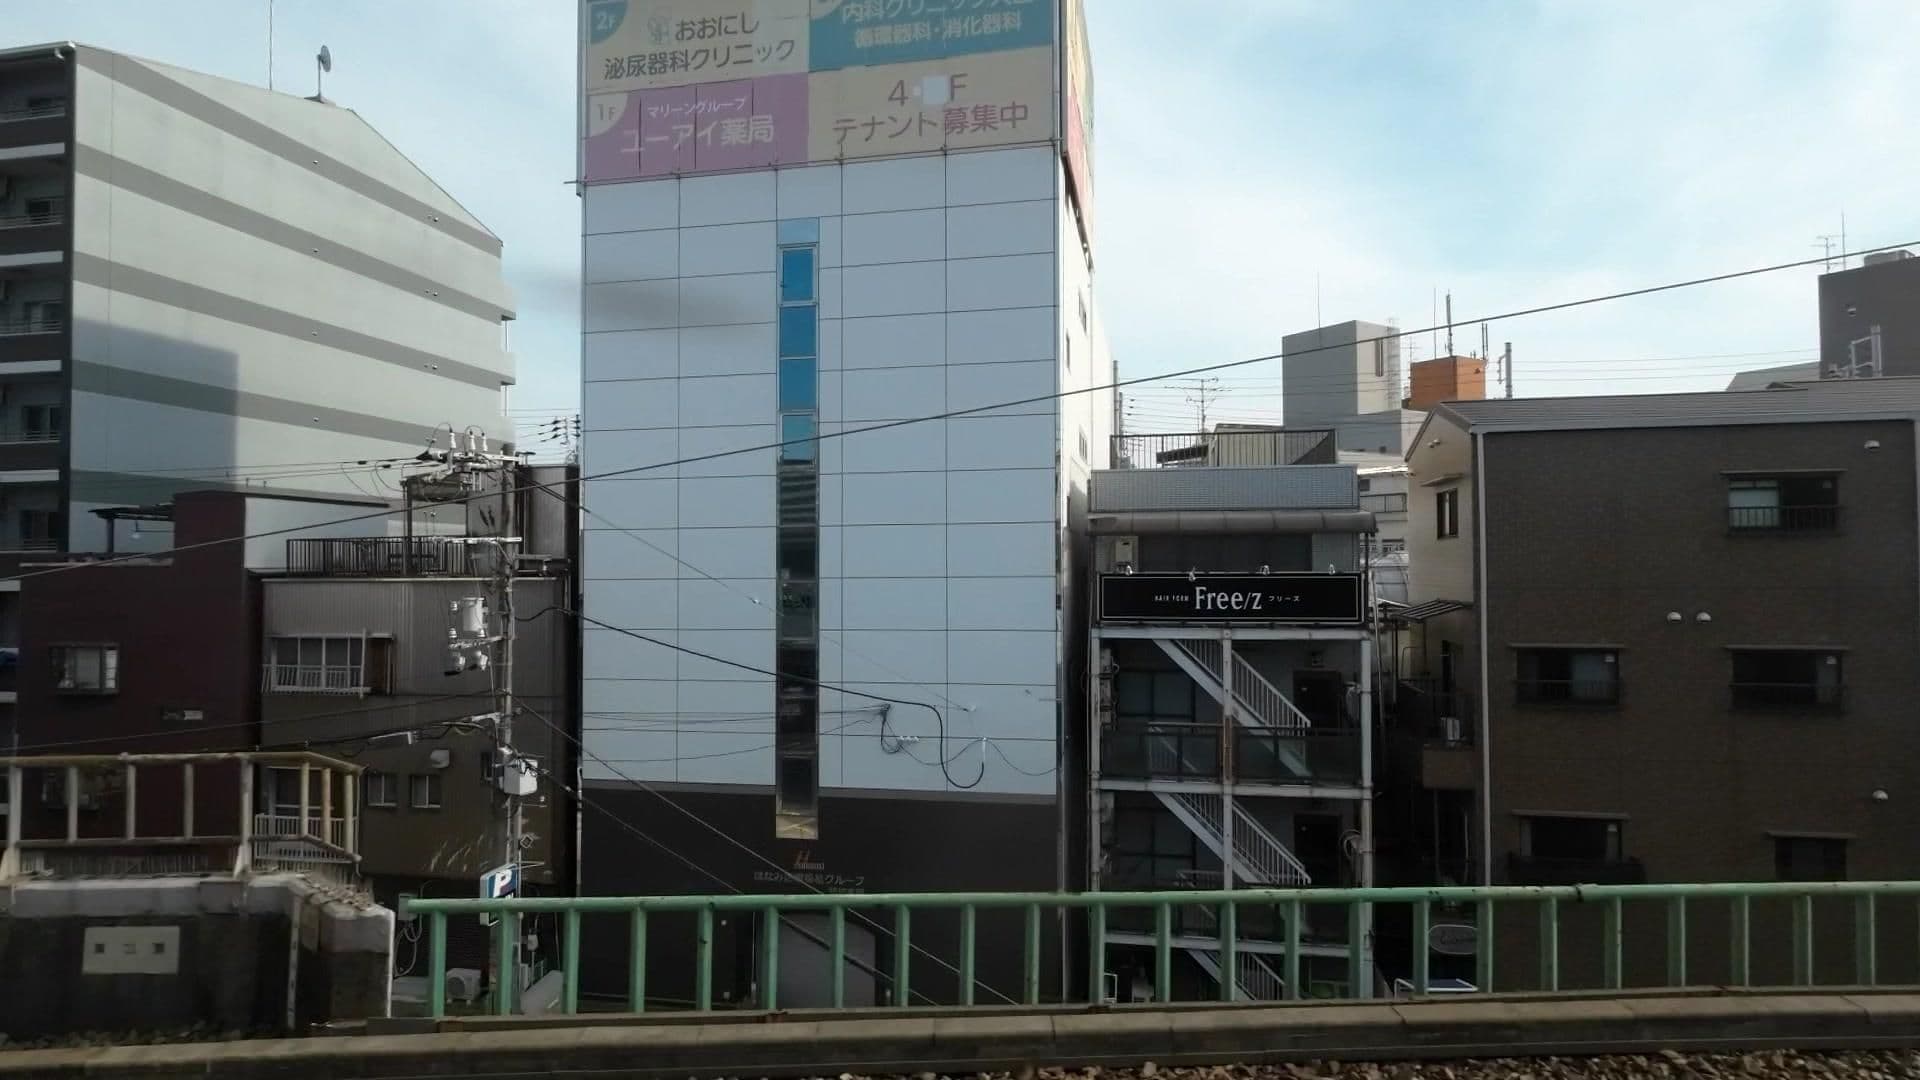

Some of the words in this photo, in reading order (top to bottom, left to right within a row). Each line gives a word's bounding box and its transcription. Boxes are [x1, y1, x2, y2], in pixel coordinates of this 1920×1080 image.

[596, 12, 616, 30] 2F
[675, 12, 759, 40] おおにし
[604, 40, 795, 79] 泌尿器科クリニック
[598, 104, 616, 120] 1F
[648, 98, 746, 118] マリーングループ
[621, 115, 774, 152] ユーアイ薬局
[833, 101, 1028, 144] テナント募集中
[1195, 586, 1262, 609] Free/z
